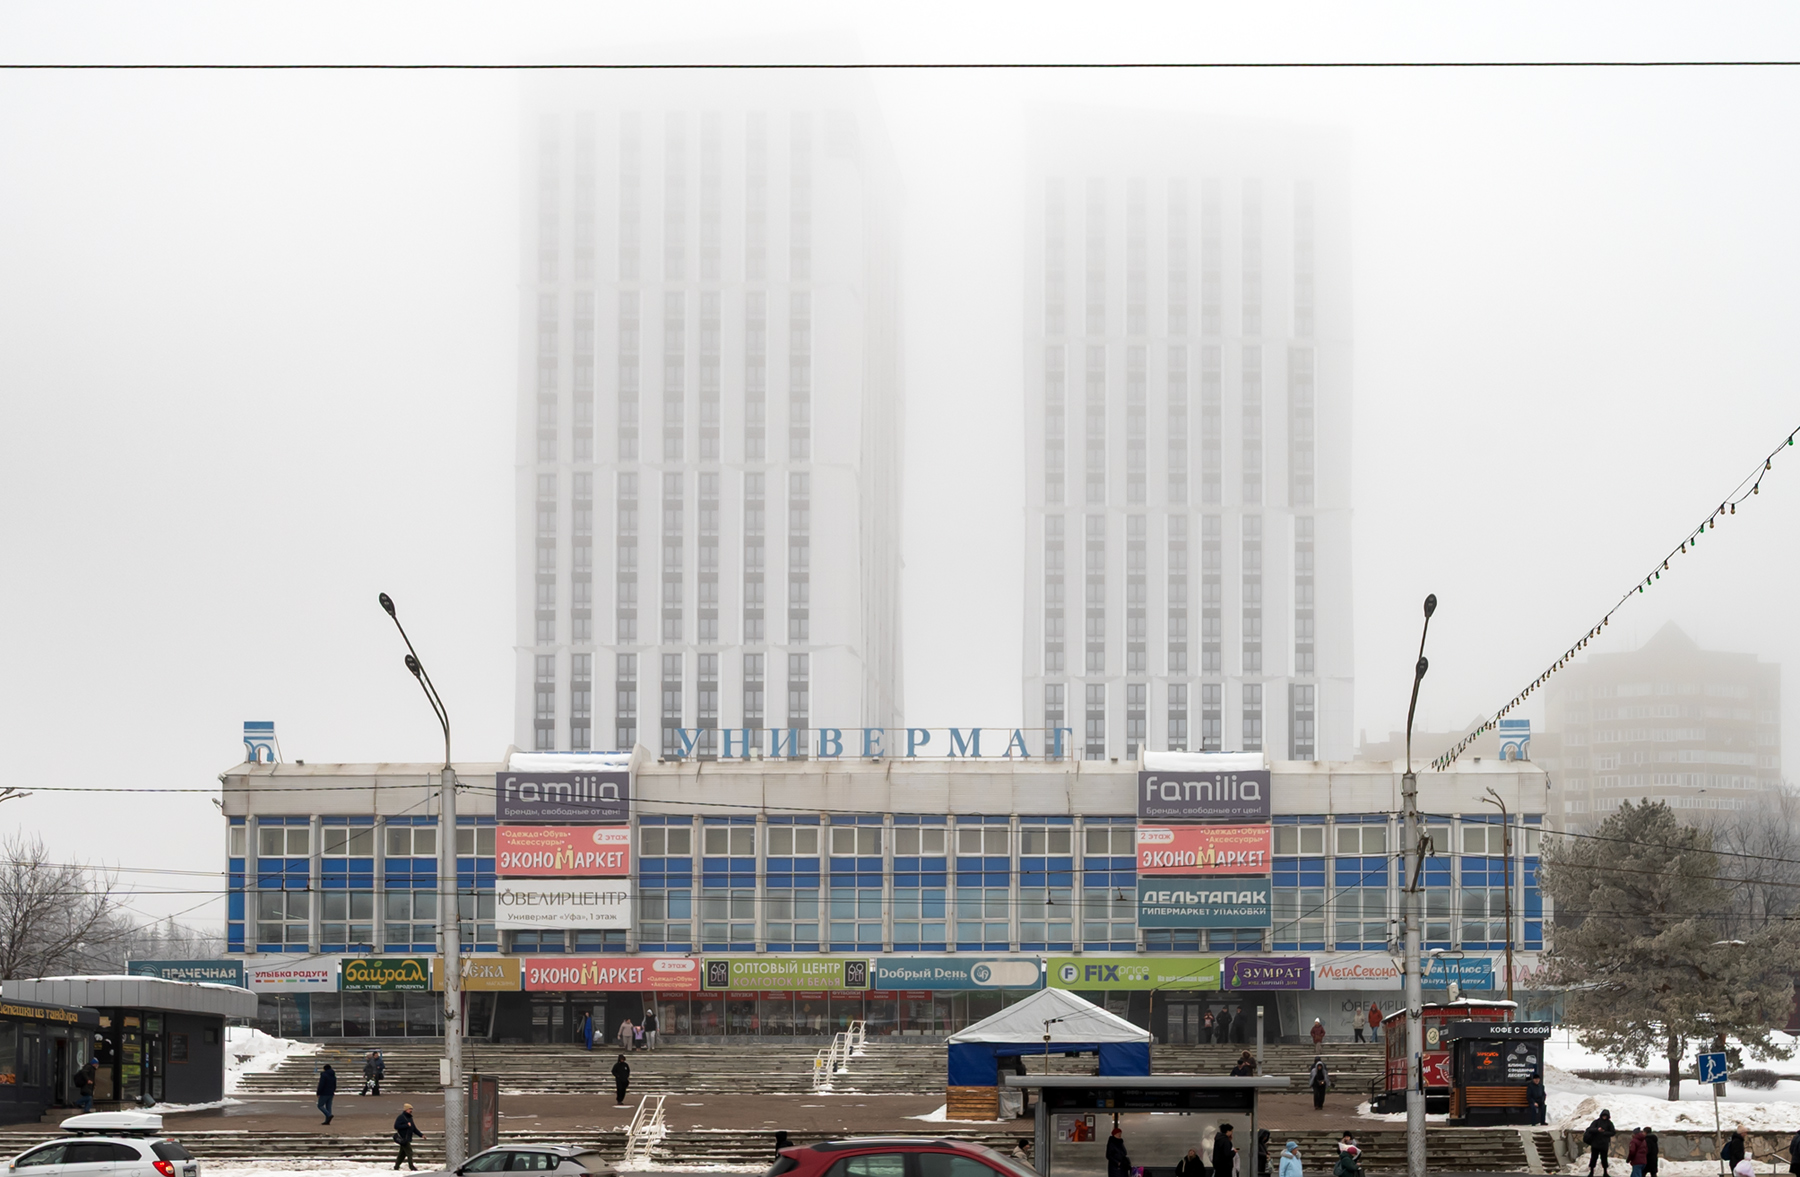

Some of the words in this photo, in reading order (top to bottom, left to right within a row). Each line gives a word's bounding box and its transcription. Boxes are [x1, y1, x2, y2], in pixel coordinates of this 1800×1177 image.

[674, 728, 1072, 757] УНИВЕРМАГ
[505, 776, 620, 802] familia
[1145, 775, 1261, 801] familia
[504, 808, 540, 817] Бренды,
[541, 808, 590, 816] свободные
[1146, 807, 1182, 815] Бренды,
[1243, 807, 1262, 815] цен!
[500, 845, 624, 870] ЭКОНОМАРКЕТ
[1142, 844, 1265, 869] ЭКОНОМАРКЕТ
[498, 891, 628, 906] ЮВЕЛИРЦЕНТР
[1142, 890, 1267, 905] ДЕЛЬТАПАК
[507, 912, 558, 921] Универмаг
[590, 912, 594, 920] 1
[1142, 907, 1210, 915] ГИПЕРМАРКЕТ
[1213, 907, 1267, 915] УПАКОВКИ
[161, 967, 237, 979] ПРАЧЕЧНАЯ
[530, 961, 644, 985] ЭКОНОМАРКЕТ
[733, 960, 798, 974] ОПТОВЫЙ
[802, 962, 841, 975] ЦЕНТР
[1243, 967, 1303, 978] ЗУМРАТ
[733, 977, 793, 987] КОЛГОТОК
[796, 977, 804, 987] И
[807, 977, 841, 987] БЕЛЬЯ
[35, 1008, 45, 1019] из
[1490, 1026, 1512, 1034] КОФЕ
[1514, 1026, 1520, 1034] С
[1523, 1025, 1550, 1034] СОБОЙ
